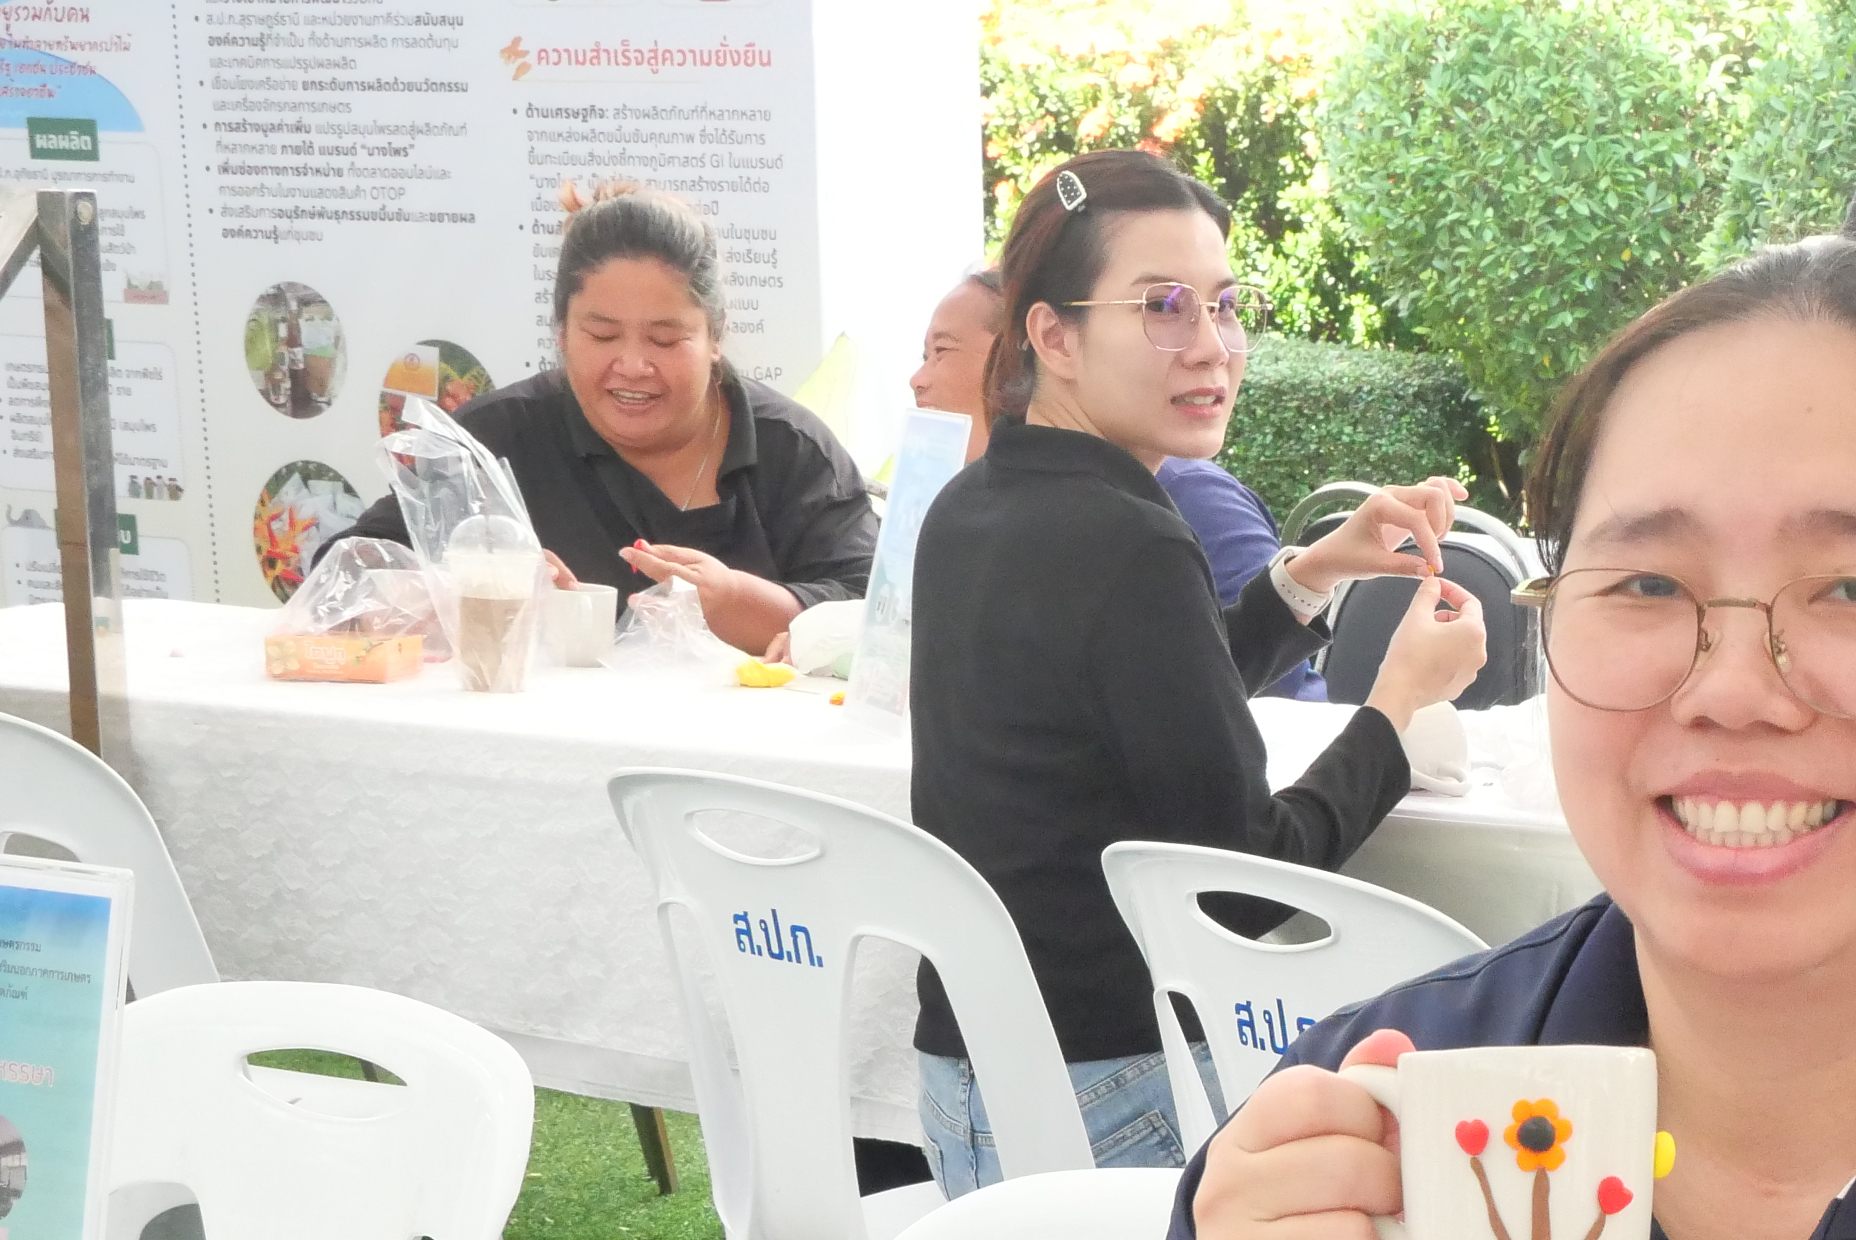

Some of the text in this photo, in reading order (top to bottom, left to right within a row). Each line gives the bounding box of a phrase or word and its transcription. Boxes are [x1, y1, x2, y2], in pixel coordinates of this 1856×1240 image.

[536, 35, 772, 75] ความสำเร็จสู่ความยั่งยืน
[35, 130, 92, 151] ผลผลิต
[370, 186, 406, 200] OTOP
[732, 907, 824, 968] ส.ป.ก.
